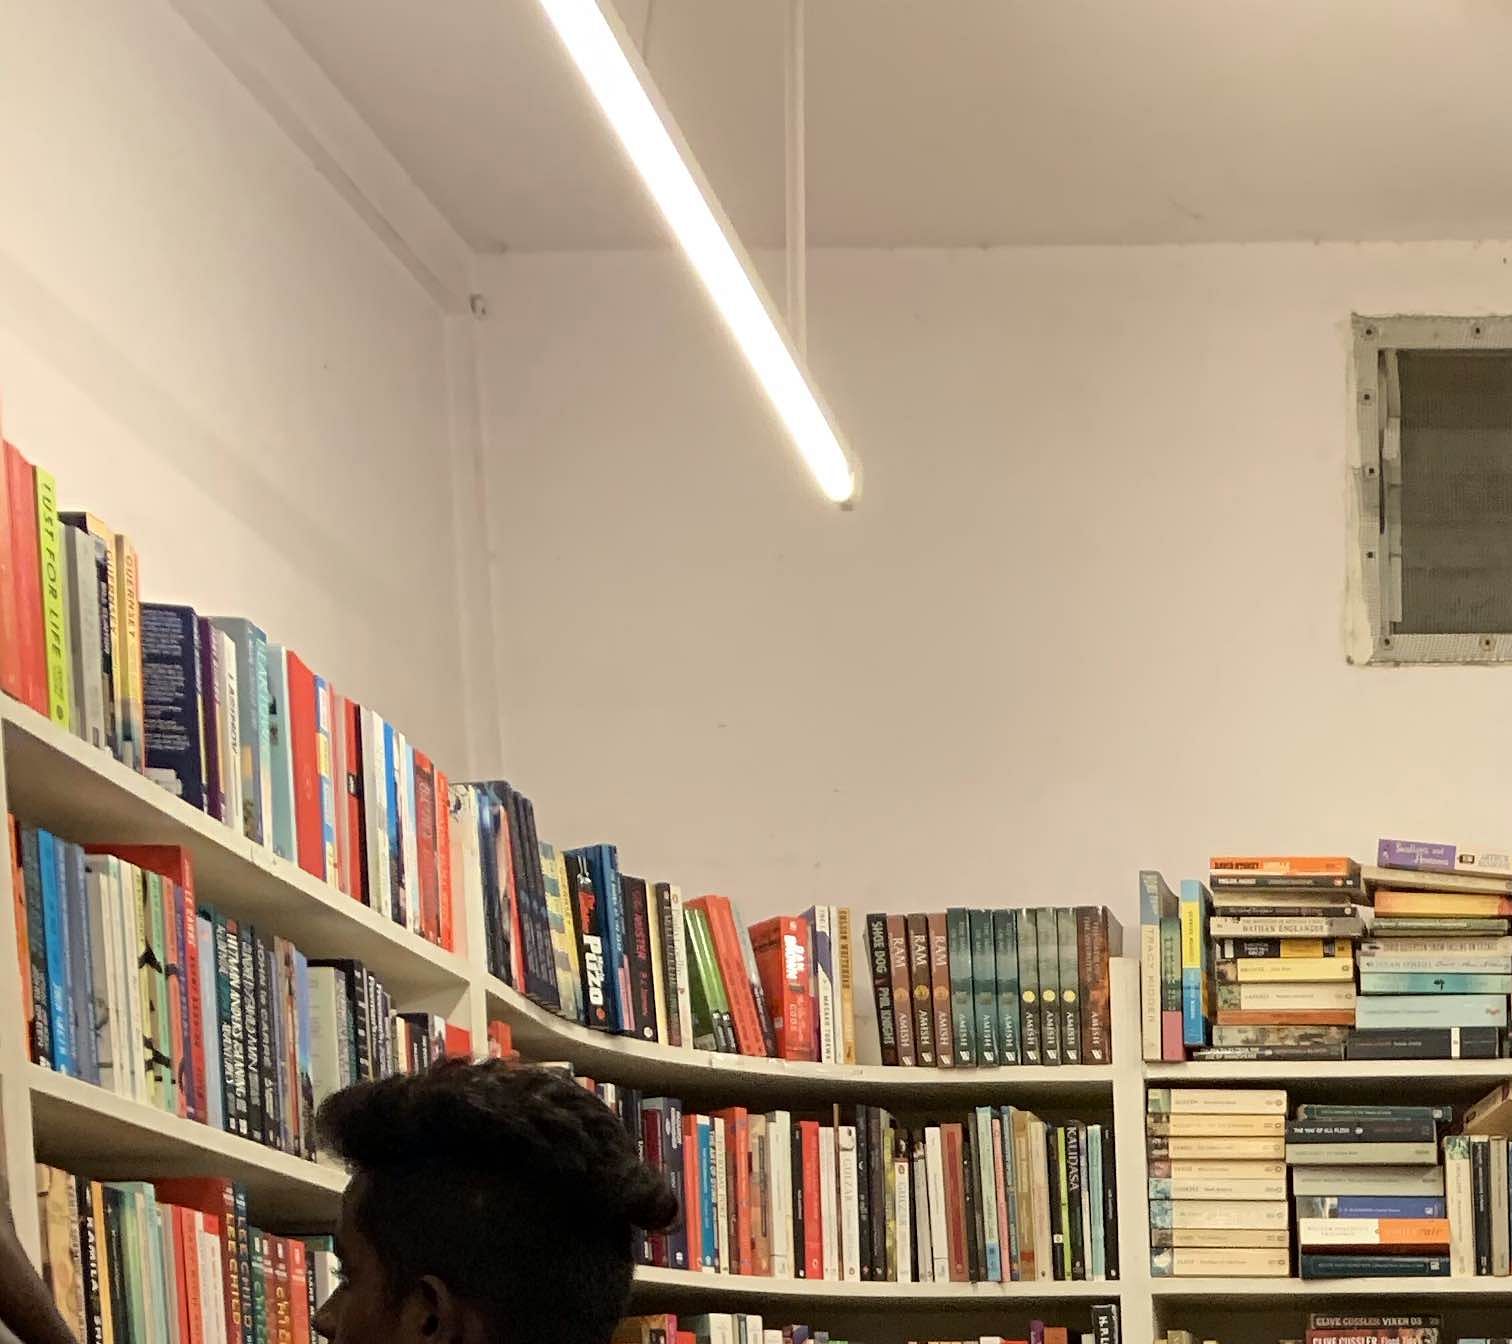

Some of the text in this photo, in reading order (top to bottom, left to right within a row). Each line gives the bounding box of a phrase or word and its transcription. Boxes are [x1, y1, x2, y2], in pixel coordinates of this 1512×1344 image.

[892, 937, 905, 968] RAM
[913, 935, 927, 966] RAM
[934, 936, 946, 966] RAM
